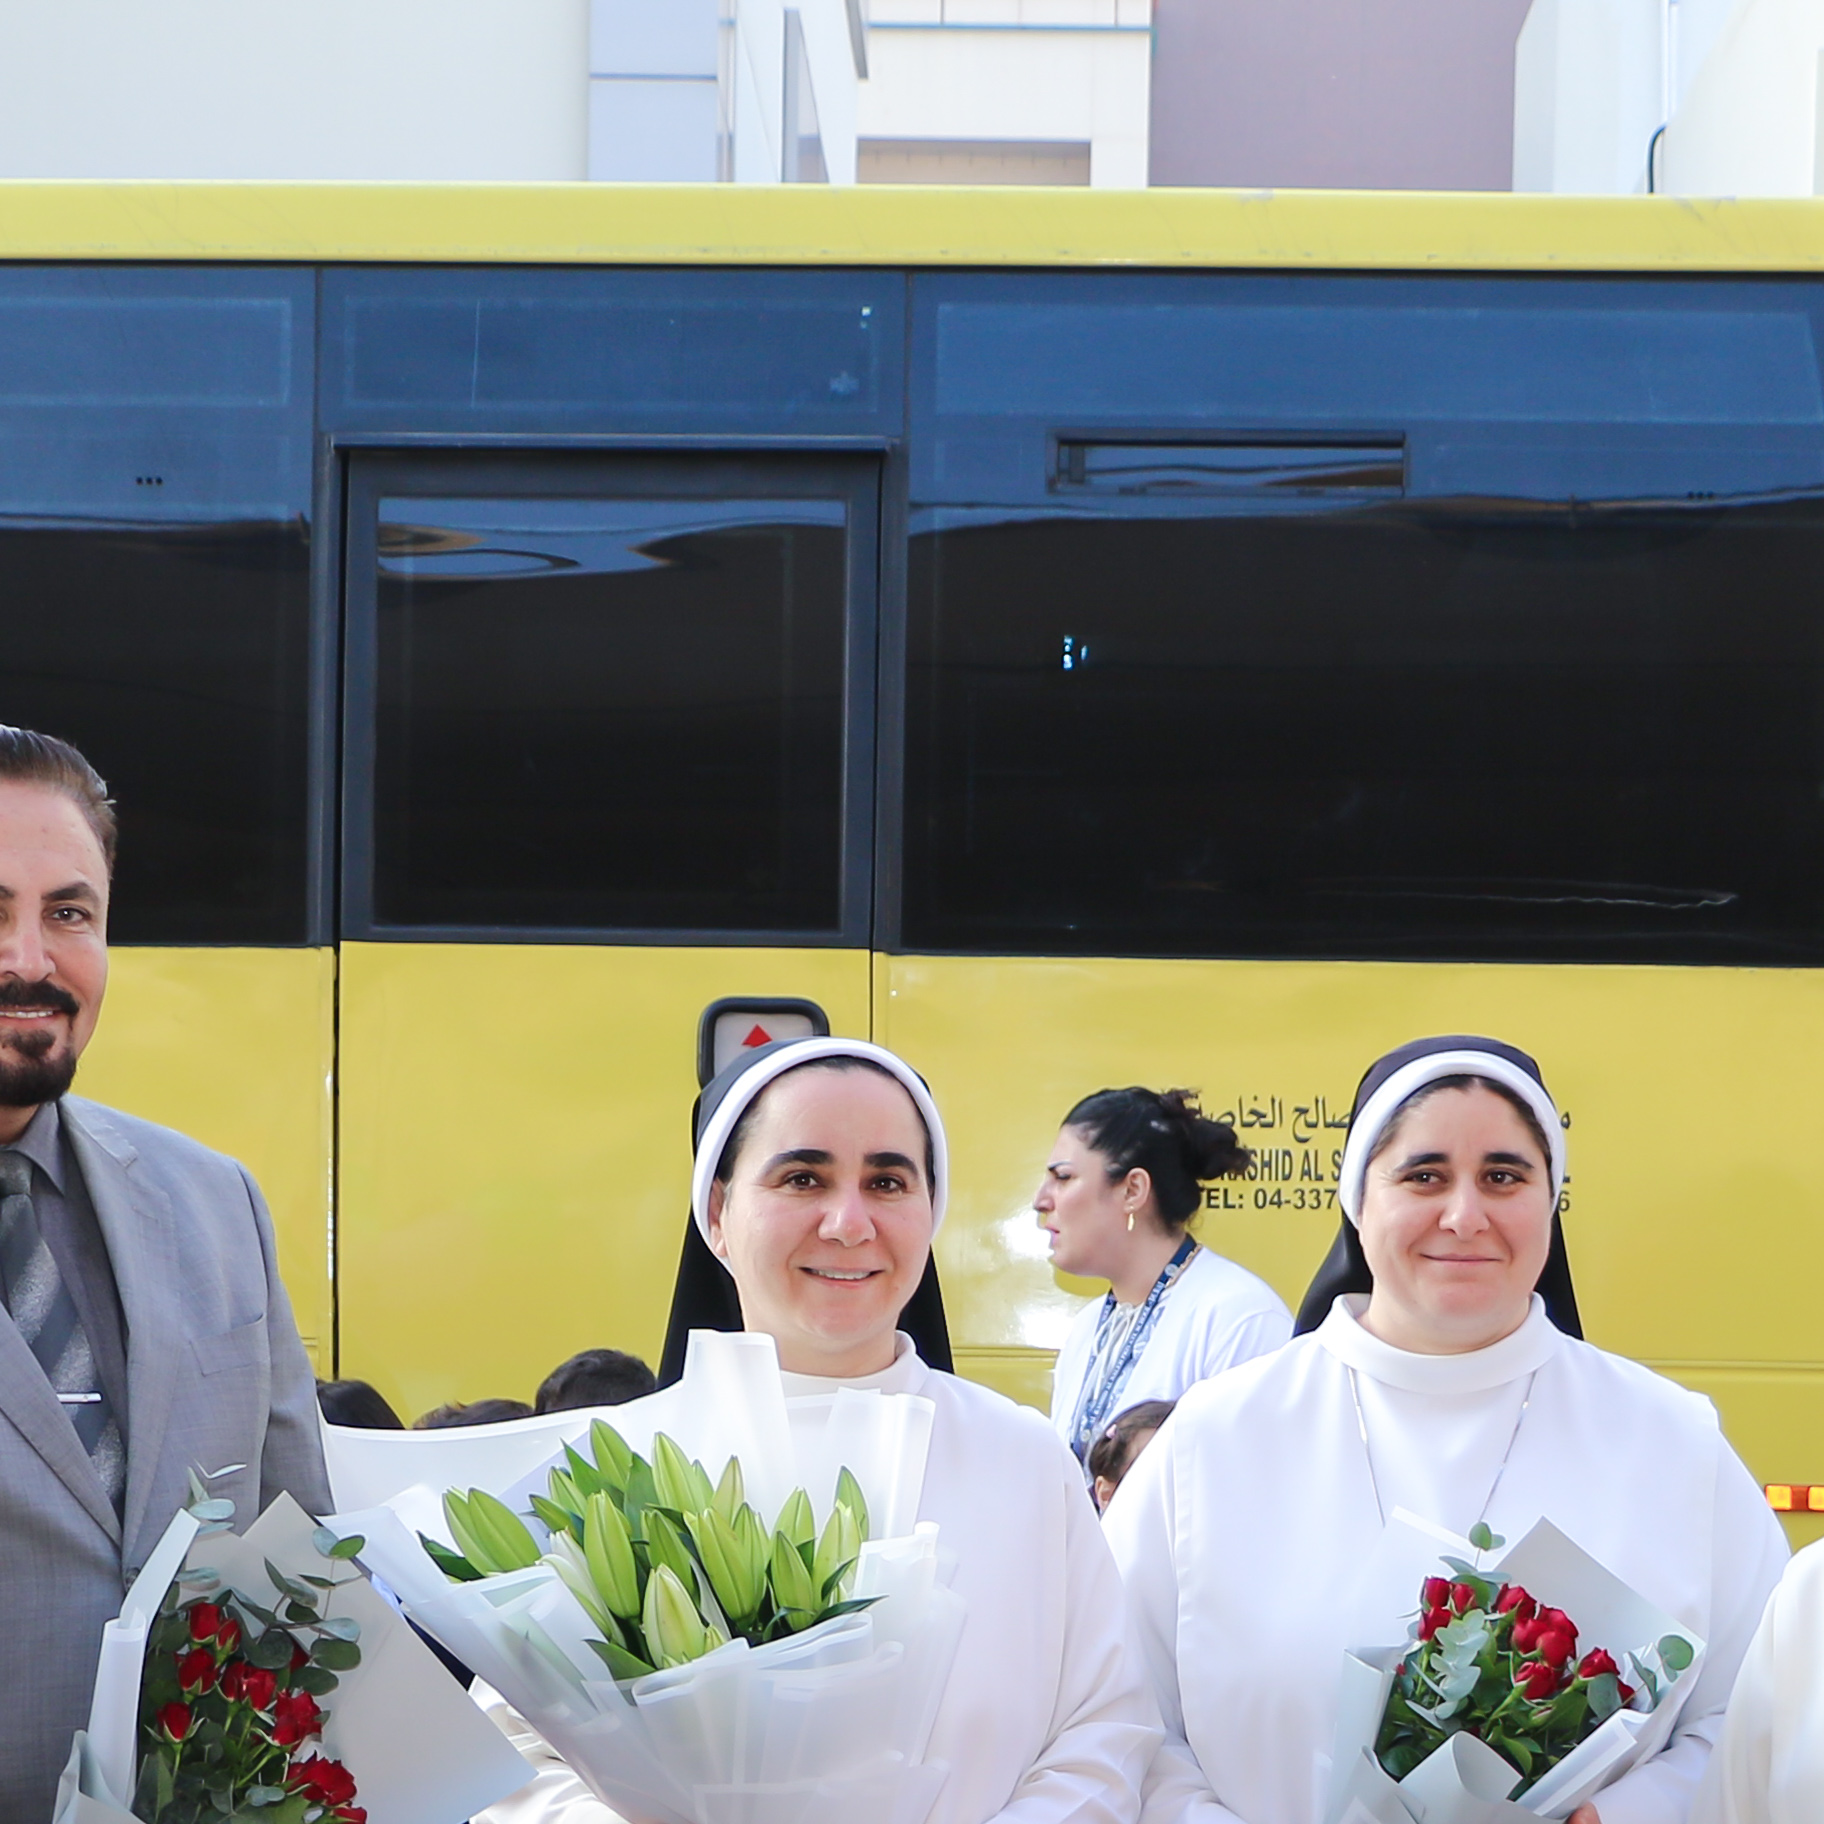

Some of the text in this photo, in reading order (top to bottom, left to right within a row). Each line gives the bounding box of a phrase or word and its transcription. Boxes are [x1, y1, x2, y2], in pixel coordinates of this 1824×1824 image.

[1299, 1148, 1324, 1181] AL
[1201, 1187, 1338, 1211] EL: 04-337
